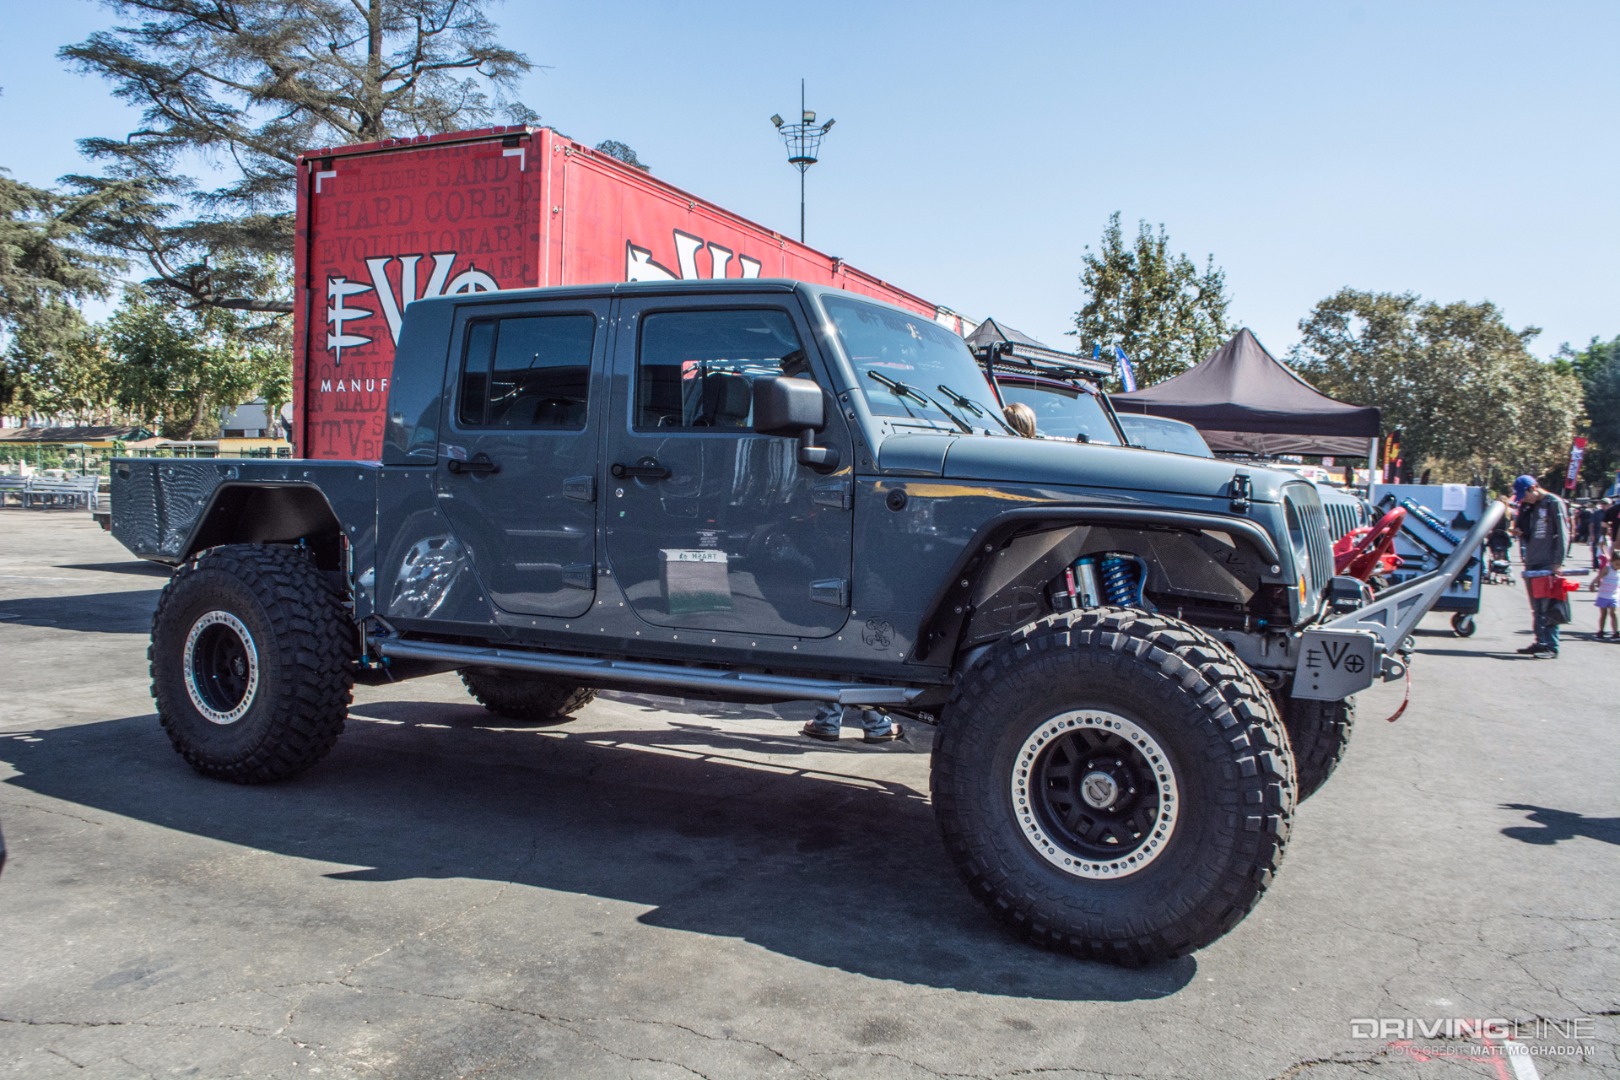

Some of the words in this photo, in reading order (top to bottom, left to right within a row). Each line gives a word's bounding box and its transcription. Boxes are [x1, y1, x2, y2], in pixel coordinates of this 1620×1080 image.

[437, 156, 509, 187] SAND
[335, 194, 414, 230] HARD
[425, 185, 511, 224] CORE
[1306, 640, 1365, 674] EVO
